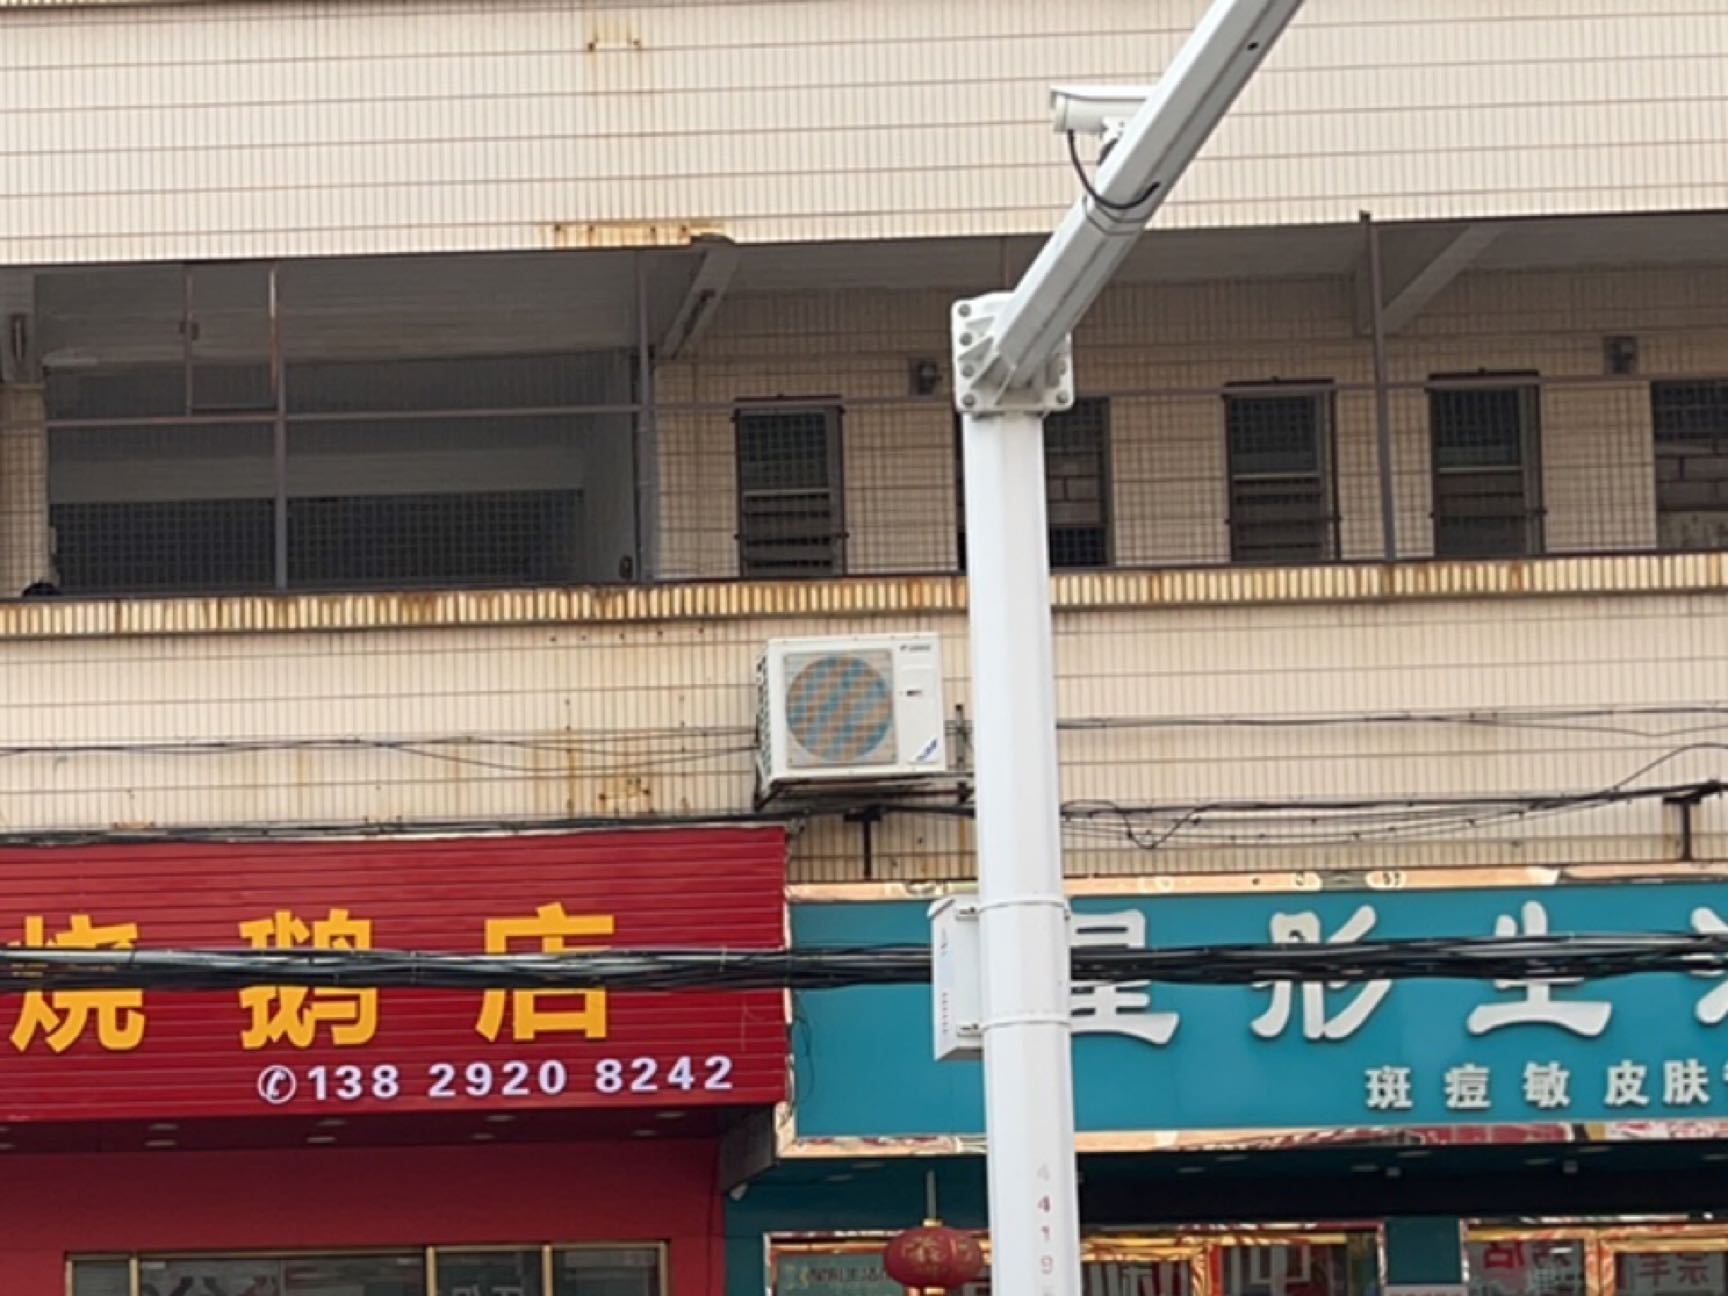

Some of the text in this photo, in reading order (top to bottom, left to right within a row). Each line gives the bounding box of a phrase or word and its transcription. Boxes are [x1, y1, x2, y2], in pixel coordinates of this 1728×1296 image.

[1071, 901, 1728, 1045] 星形生
[308, 1056, 733, 1100] 138 2920 8242
[1365, 1058, 1728, 1110] 斑痘敏皮肤
